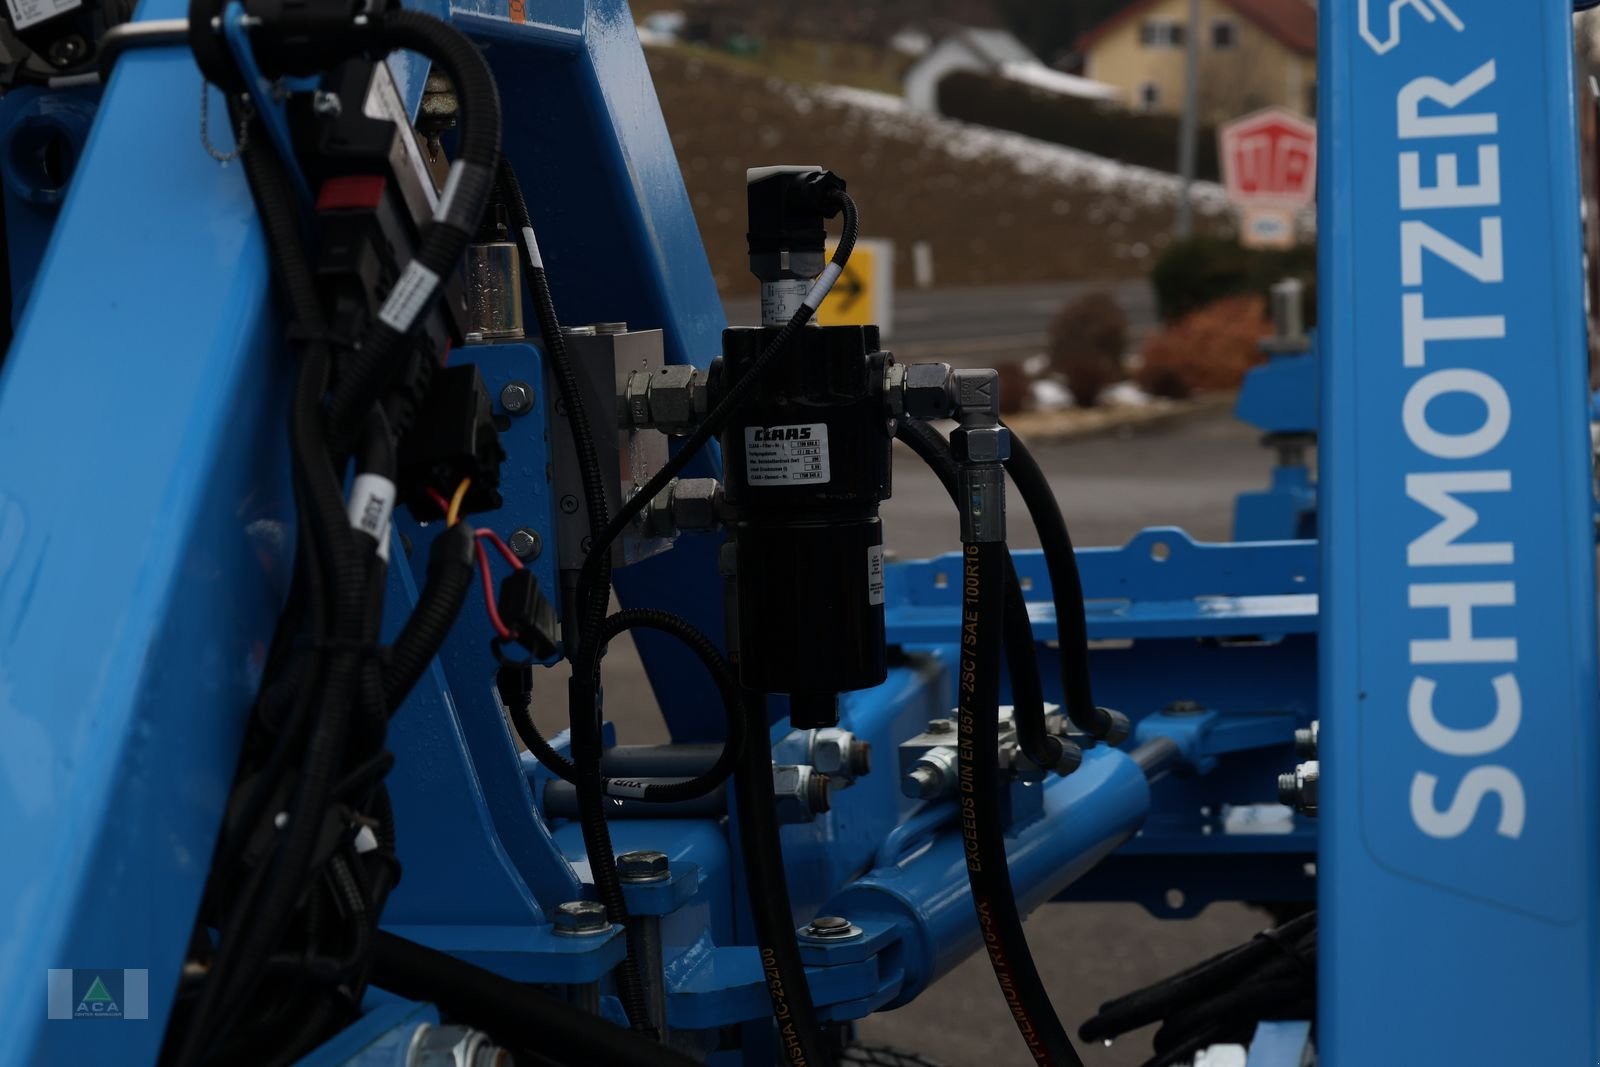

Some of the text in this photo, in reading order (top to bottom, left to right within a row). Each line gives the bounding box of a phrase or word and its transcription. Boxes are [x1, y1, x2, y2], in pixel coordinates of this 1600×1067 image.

[754, 427, 811, 441] CLAAS
[1396, 57, 1526, 840] SCHMOTZER
[965, 542, 980, 604] 100R16
[964, 609, 979, 646] SAE
[961, 659, 976, 693] 2SC
[960, 705, 974, 735] 857
[960, 737, 974, 761] EN
[960, 765, 975, 793] DIN
[960, 796, 982, 873] EXCEEDS
[761, 947, 791, 1021] IC-252/00
[999, 973, 1046, 1059] PREMIUM
